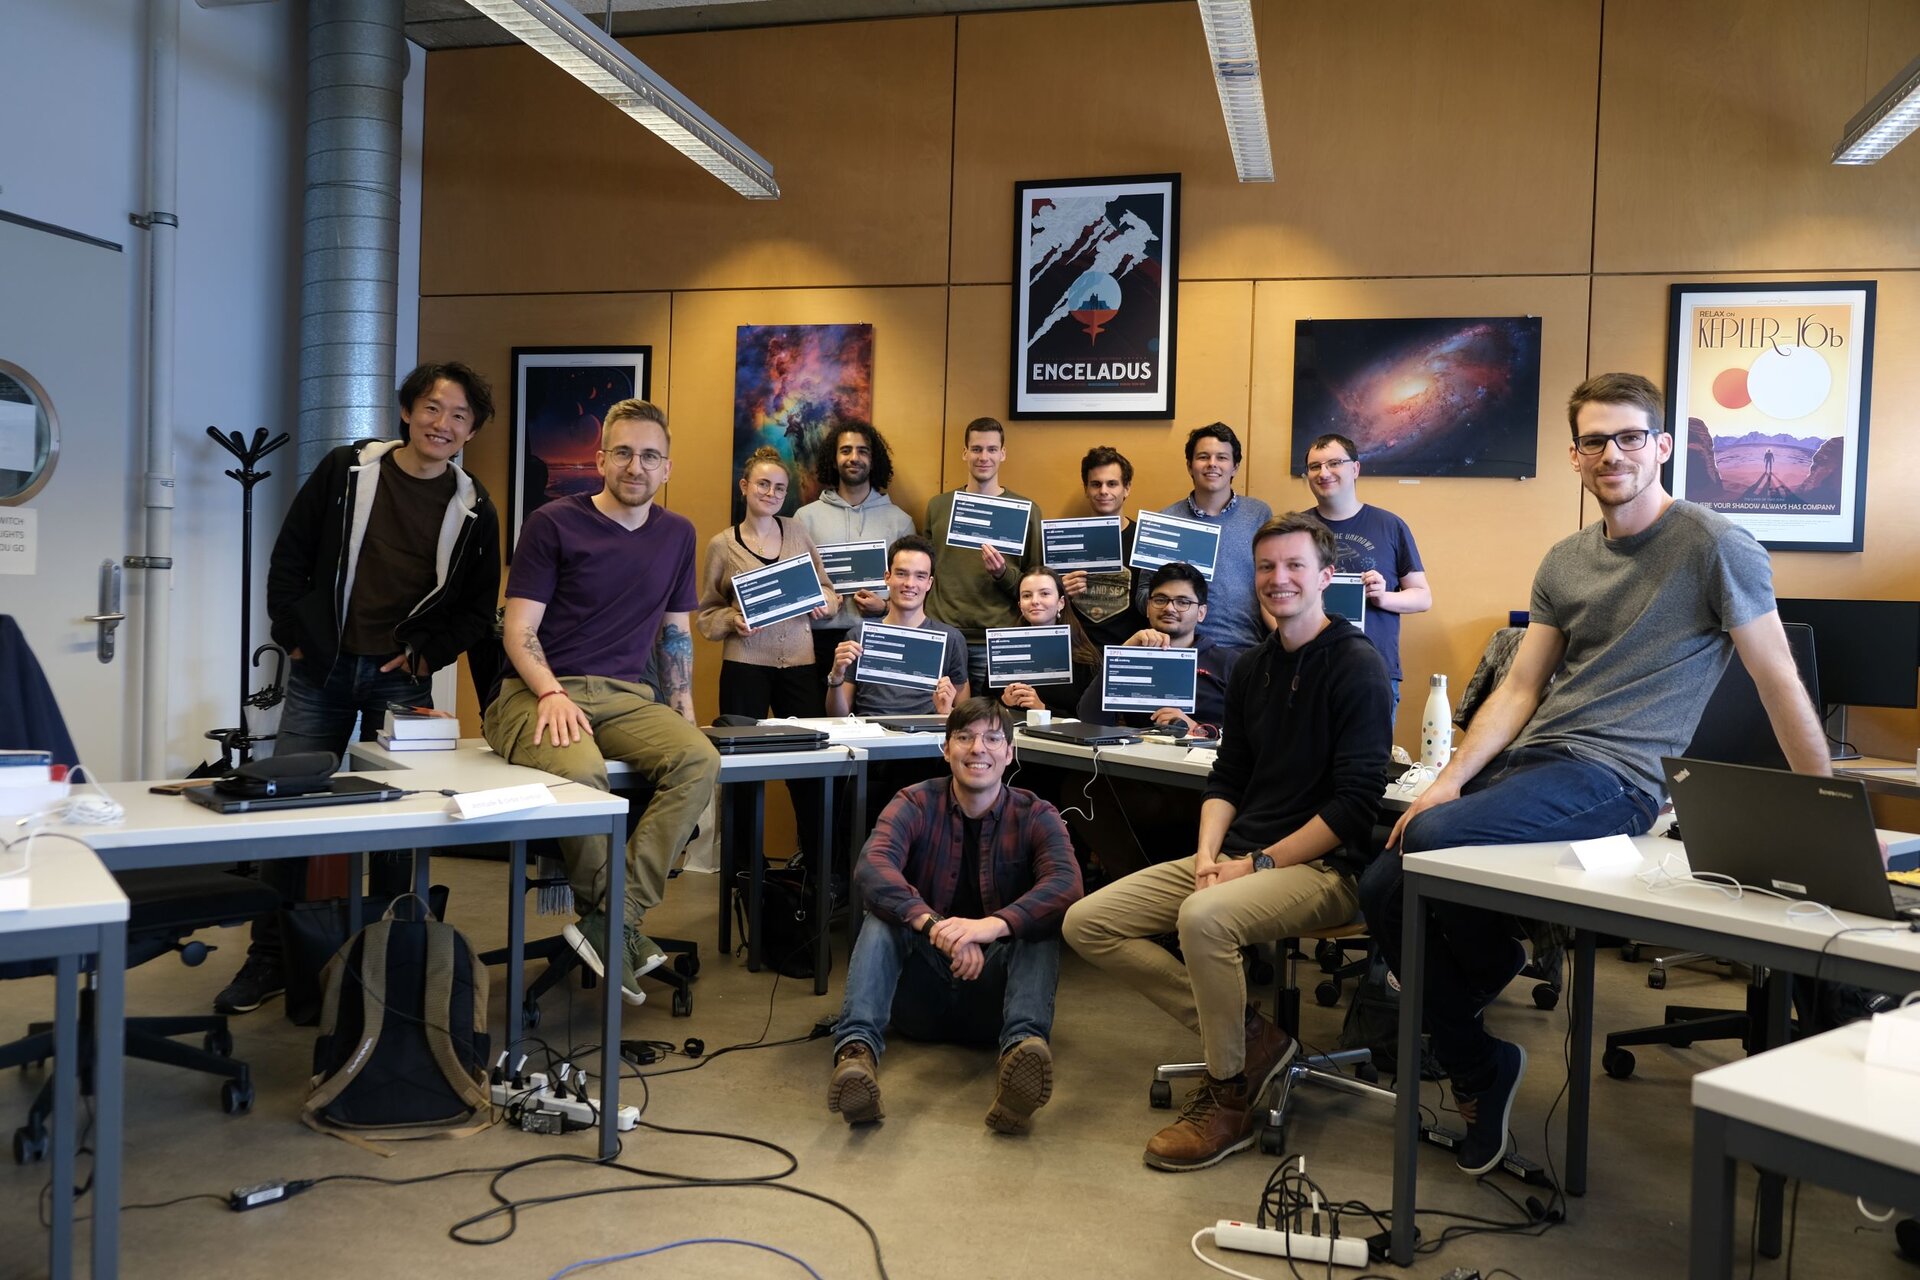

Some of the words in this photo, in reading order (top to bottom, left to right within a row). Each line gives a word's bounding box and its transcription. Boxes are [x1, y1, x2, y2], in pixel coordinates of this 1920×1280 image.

[1032, 362, 1151, 380] ENCELADUS
[1731, 502, 1760, 510] SHADOW
[1802, 503, 1836, 511] COMPANY
[1333, 532, 1344, 540] HE
[1345, 532, 1375, 551] UNKNOWN
[12, 544, 25, 552] GO
[1090, 584, 1107, 595] AND
[1109, 585, 1125, 596] SEA
